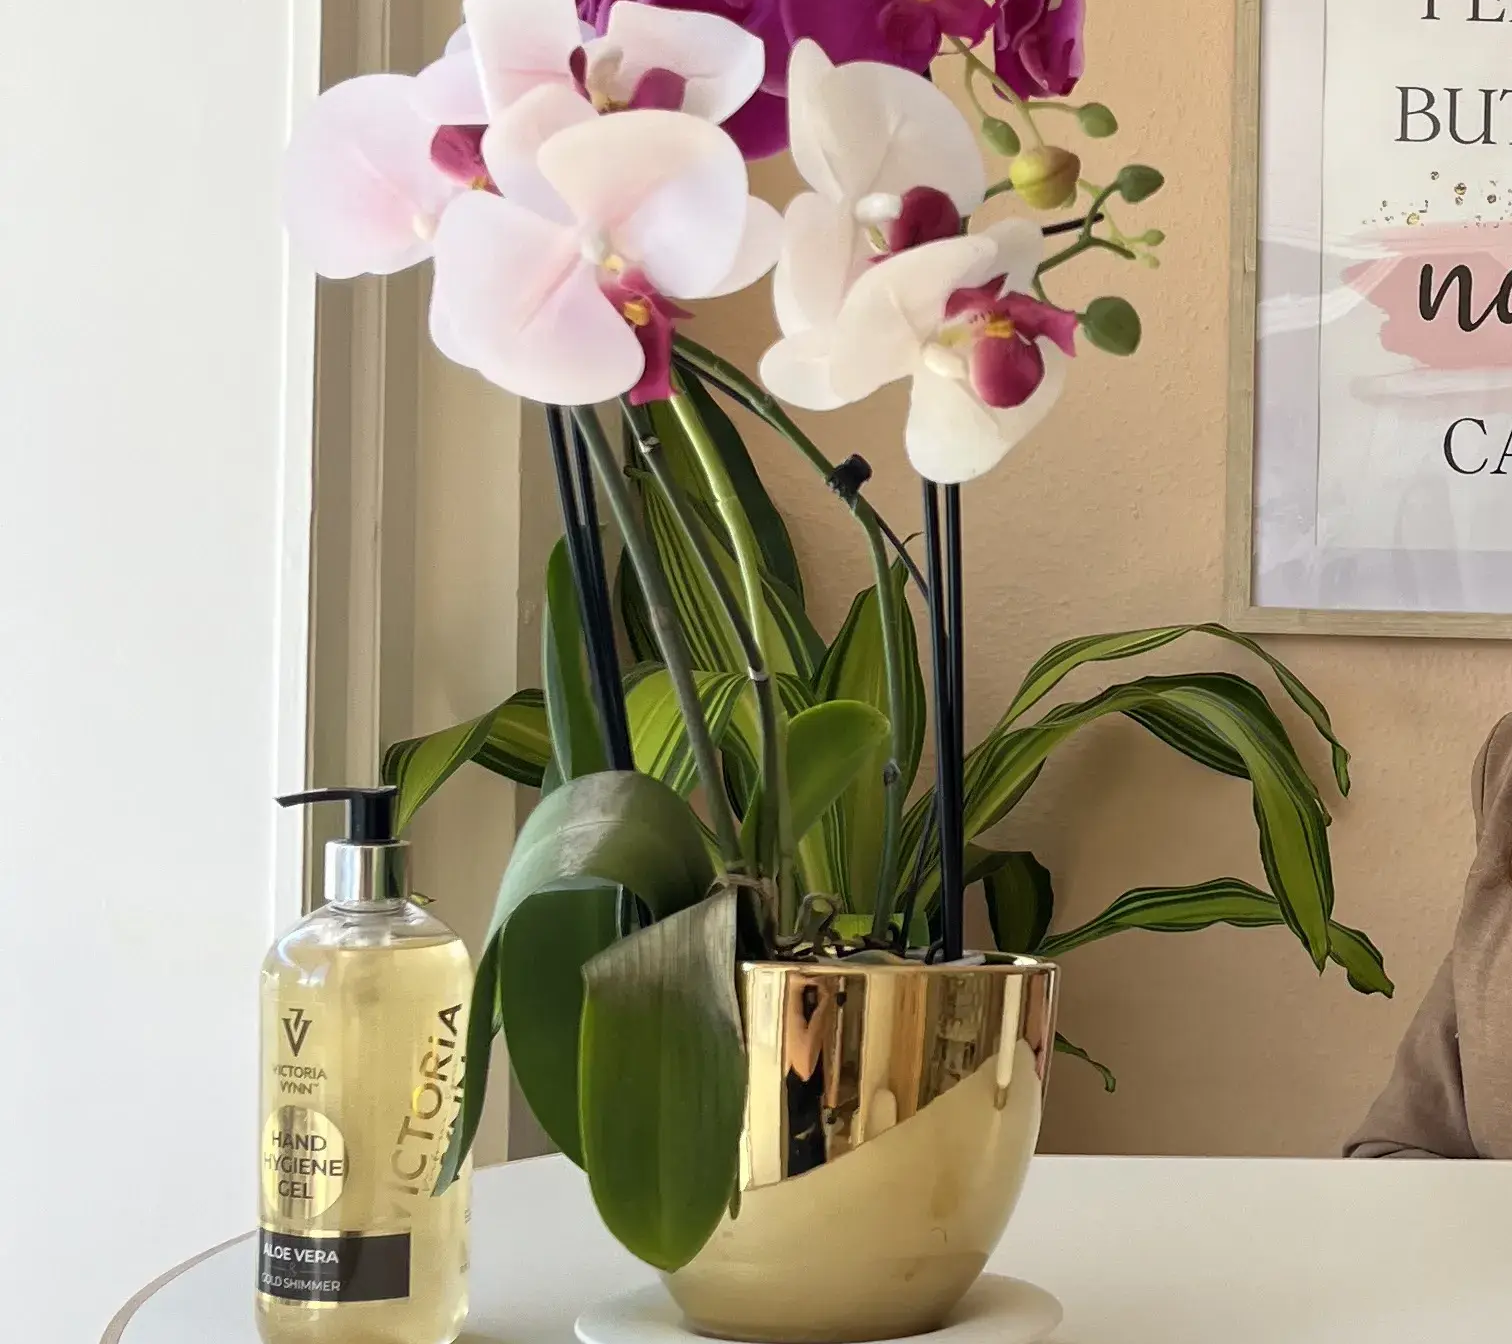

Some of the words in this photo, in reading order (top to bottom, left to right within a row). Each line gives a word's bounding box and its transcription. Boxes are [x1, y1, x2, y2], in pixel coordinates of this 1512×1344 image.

[272, 1130, 327, 1152] HAND
[263, 1151, 345, 1177] HYGIENE
[278, 1179, 314, 1200] GEL
[263, 1242, 292, 1261] ALOE
[294, 1248, 340, 1264] VERA
[283, 1277, 341, 1292] SHIMMER
